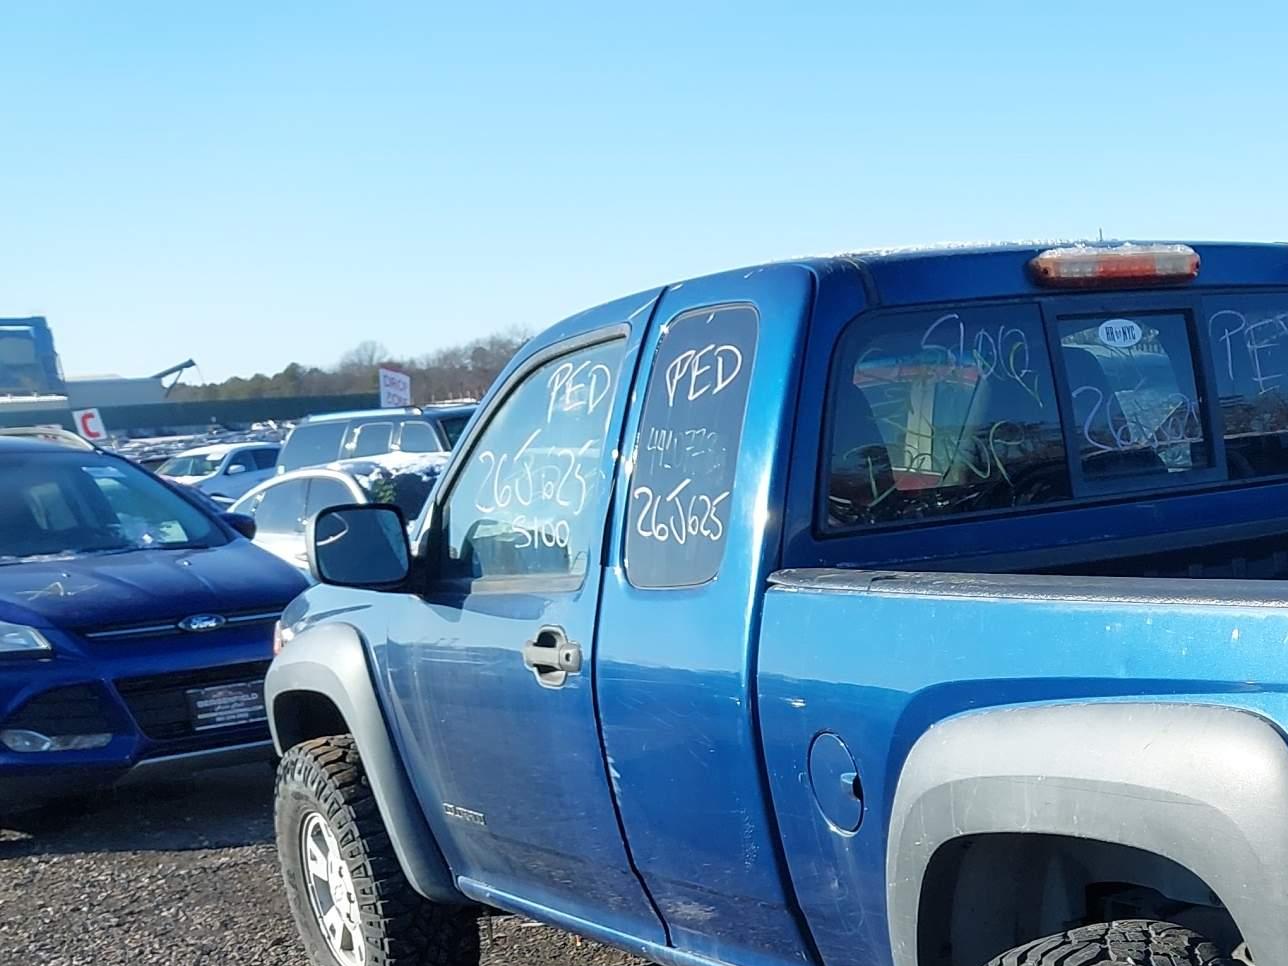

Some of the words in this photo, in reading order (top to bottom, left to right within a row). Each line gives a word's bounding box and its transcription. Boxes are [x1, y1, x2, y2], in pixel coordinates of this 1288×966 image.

[547, 360, 611, 424] PED
[665, 344, 742, 407] PED
[81, 412, 101, 438] C
[634, 478, 730, 544] 26J625
